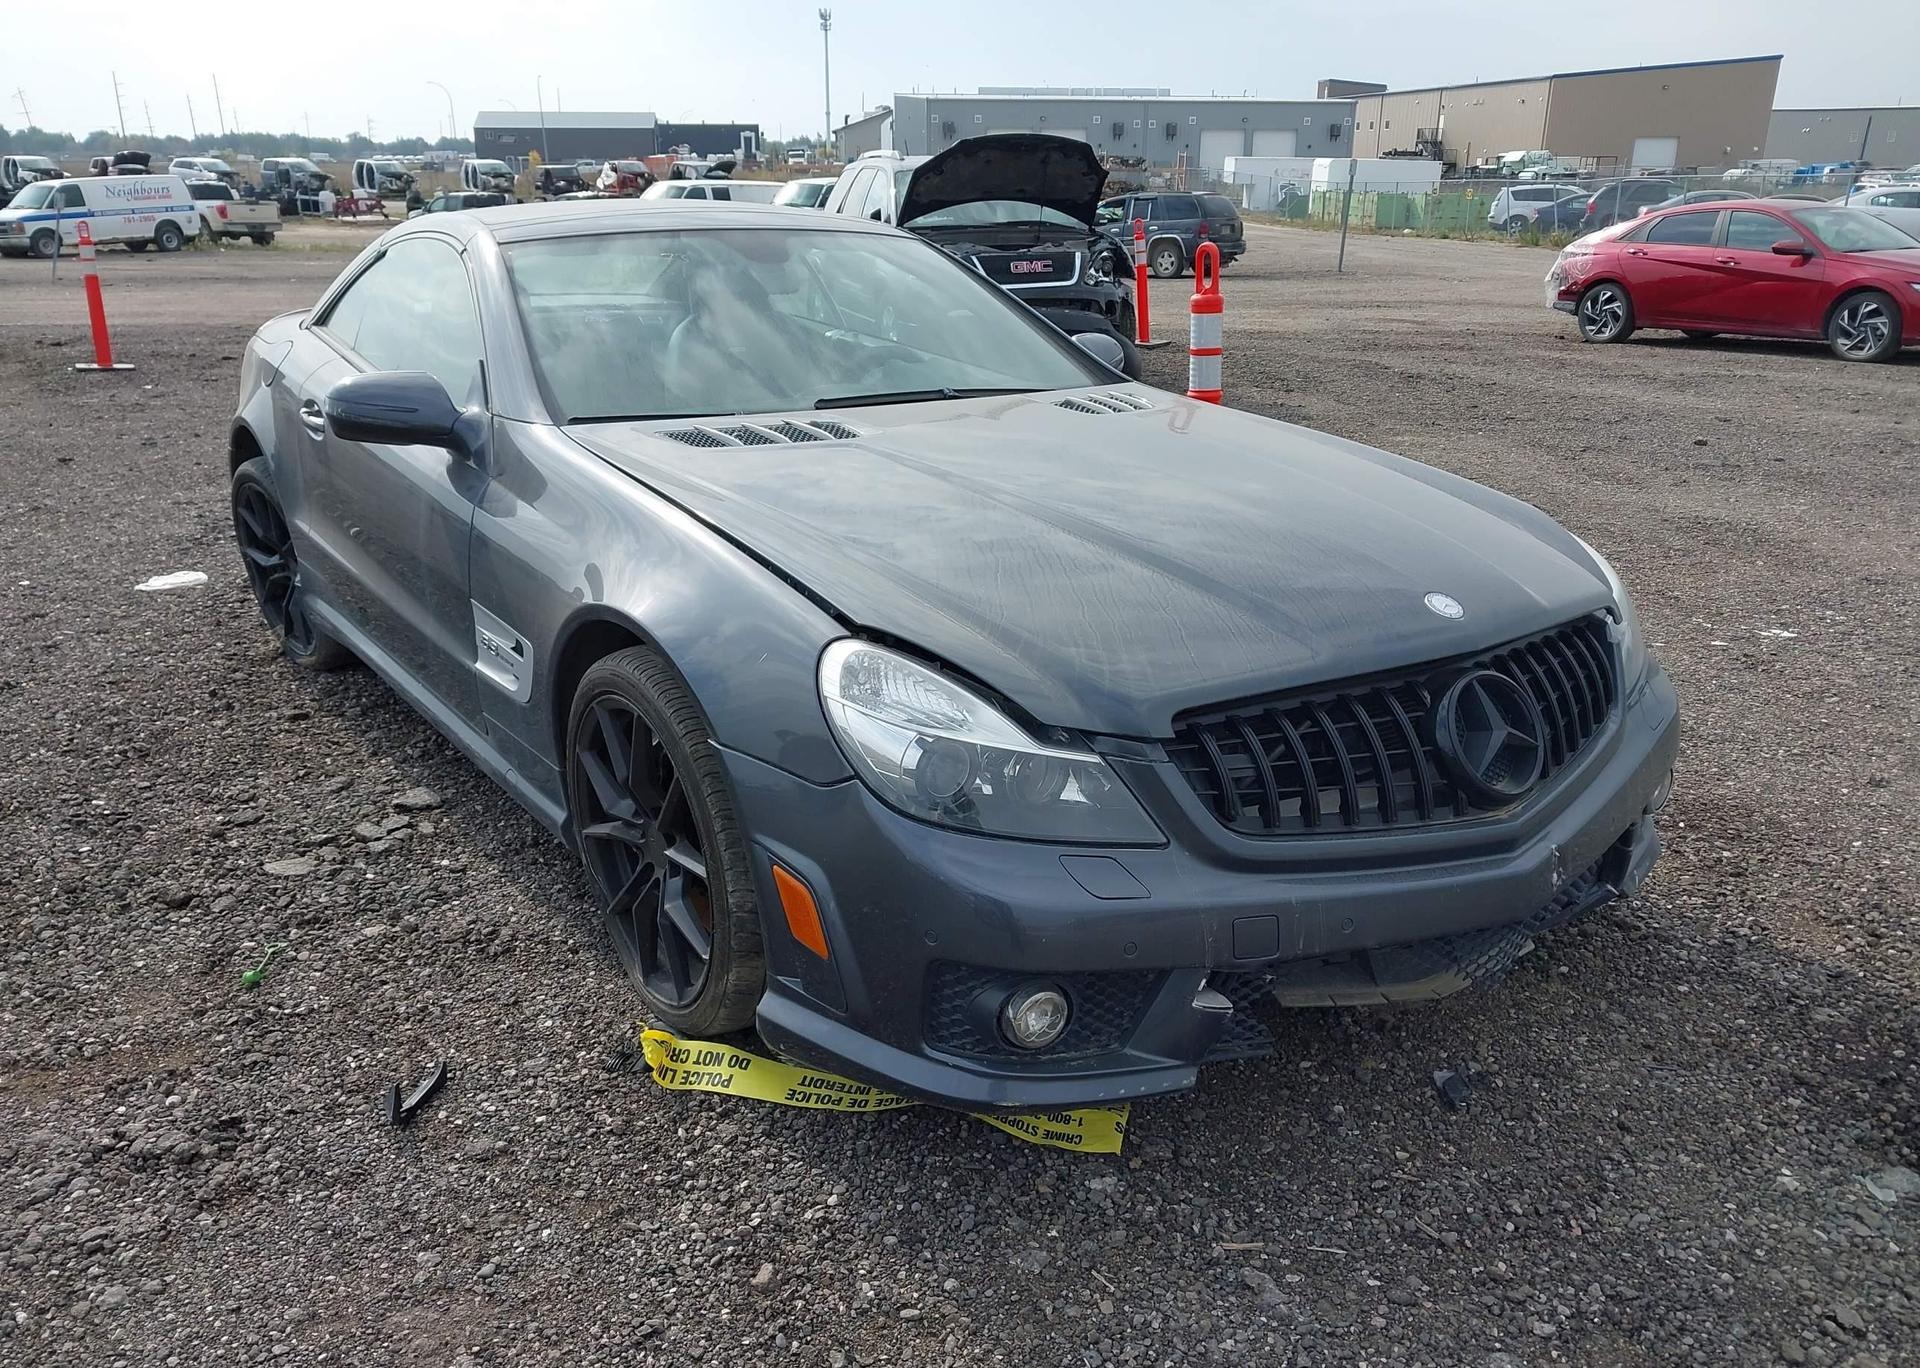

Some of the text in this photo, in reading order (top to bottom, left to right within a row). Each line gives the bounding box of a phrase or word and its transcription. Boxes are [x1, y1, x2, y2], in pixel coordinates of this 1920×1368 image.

[104, 181, 170, 201] Neighbours
[1011, 260, 1053, 273] GMC
[692, 1049, 725, 1067] NOT
[727, 1054, 752, 1071] DO
[656, 1063, 734, 1088] POLICE LIN
[797, 1075, 872, 1096] INTERDIT
[785, 1088, 843, 1106] POLICE
[846, 1098, 869, 1108] DE
[1041, 1129, 1083, 1145] CRIME
